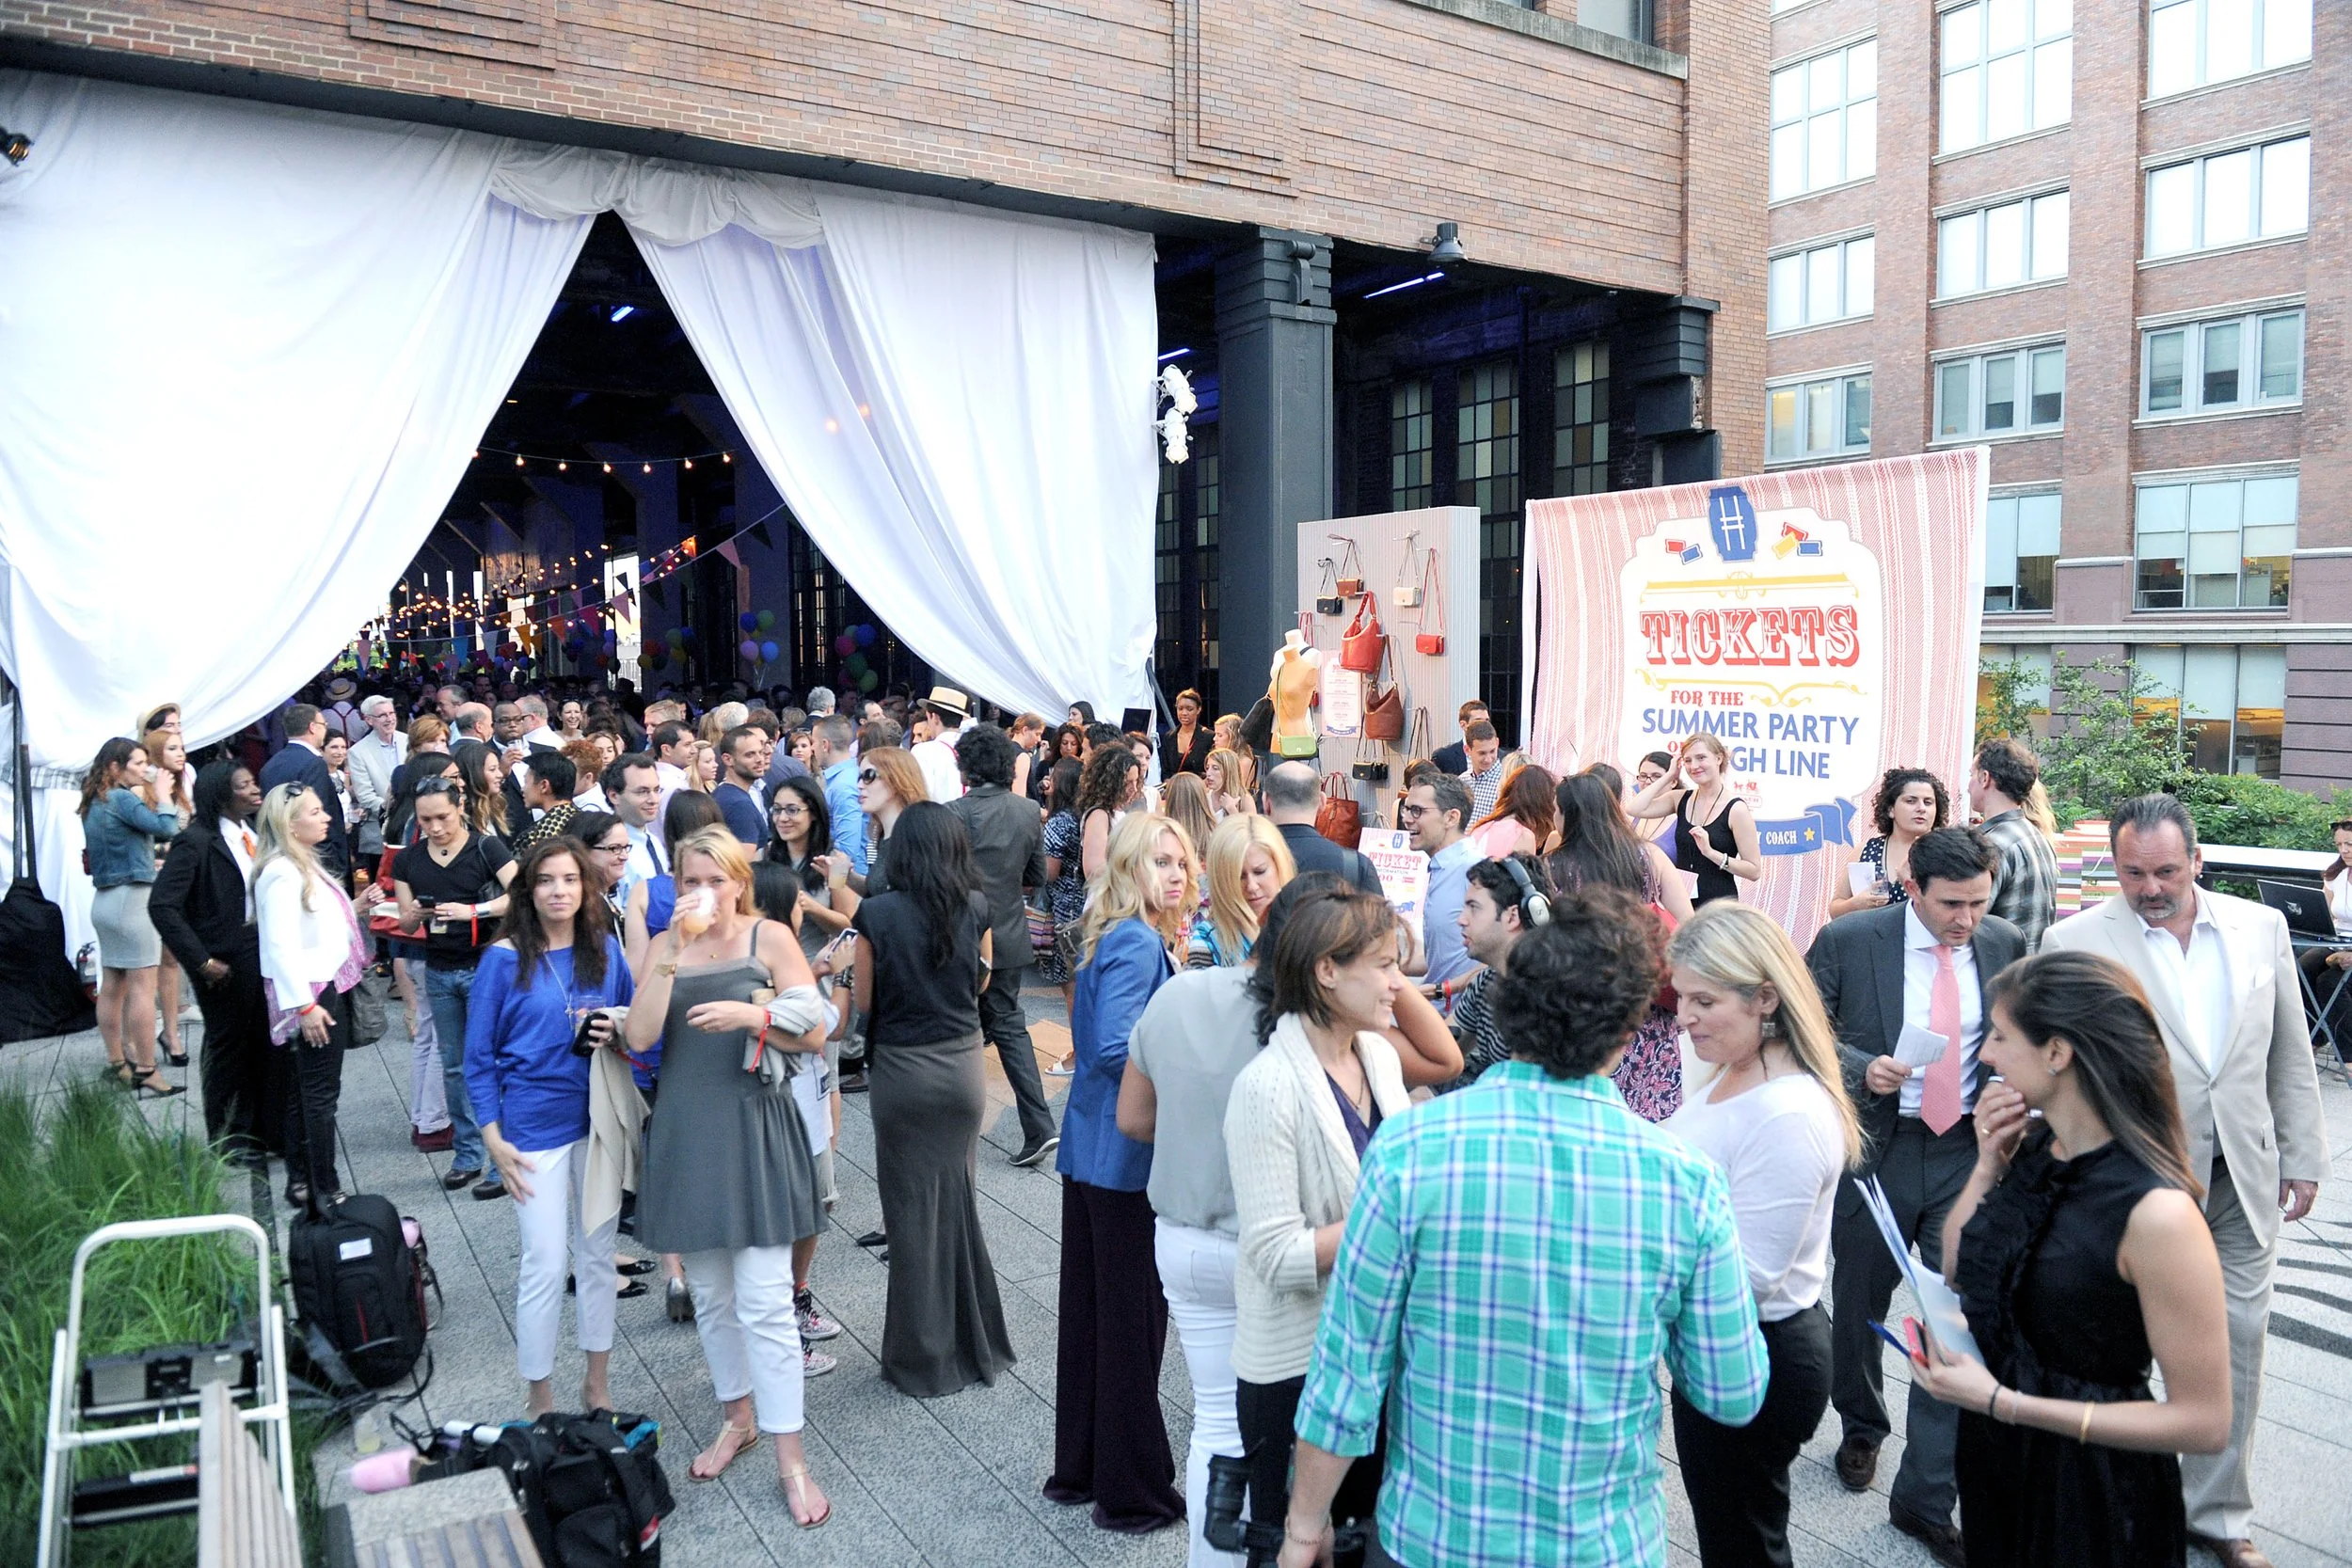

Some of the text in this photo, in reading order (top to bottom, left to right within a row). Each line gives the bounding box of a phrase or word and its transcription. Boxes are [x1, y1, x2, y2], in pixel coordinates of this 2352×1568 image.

[1640, 606, 1860, 667] TICKETS
[1671, 690, 1743, 706] FOR THE
[1642, 707, 1860, 745] SUMMER PARTY
[1727, 746, 1830, 779] GH LINE
[1765, 830, 1798, 845] COACH
